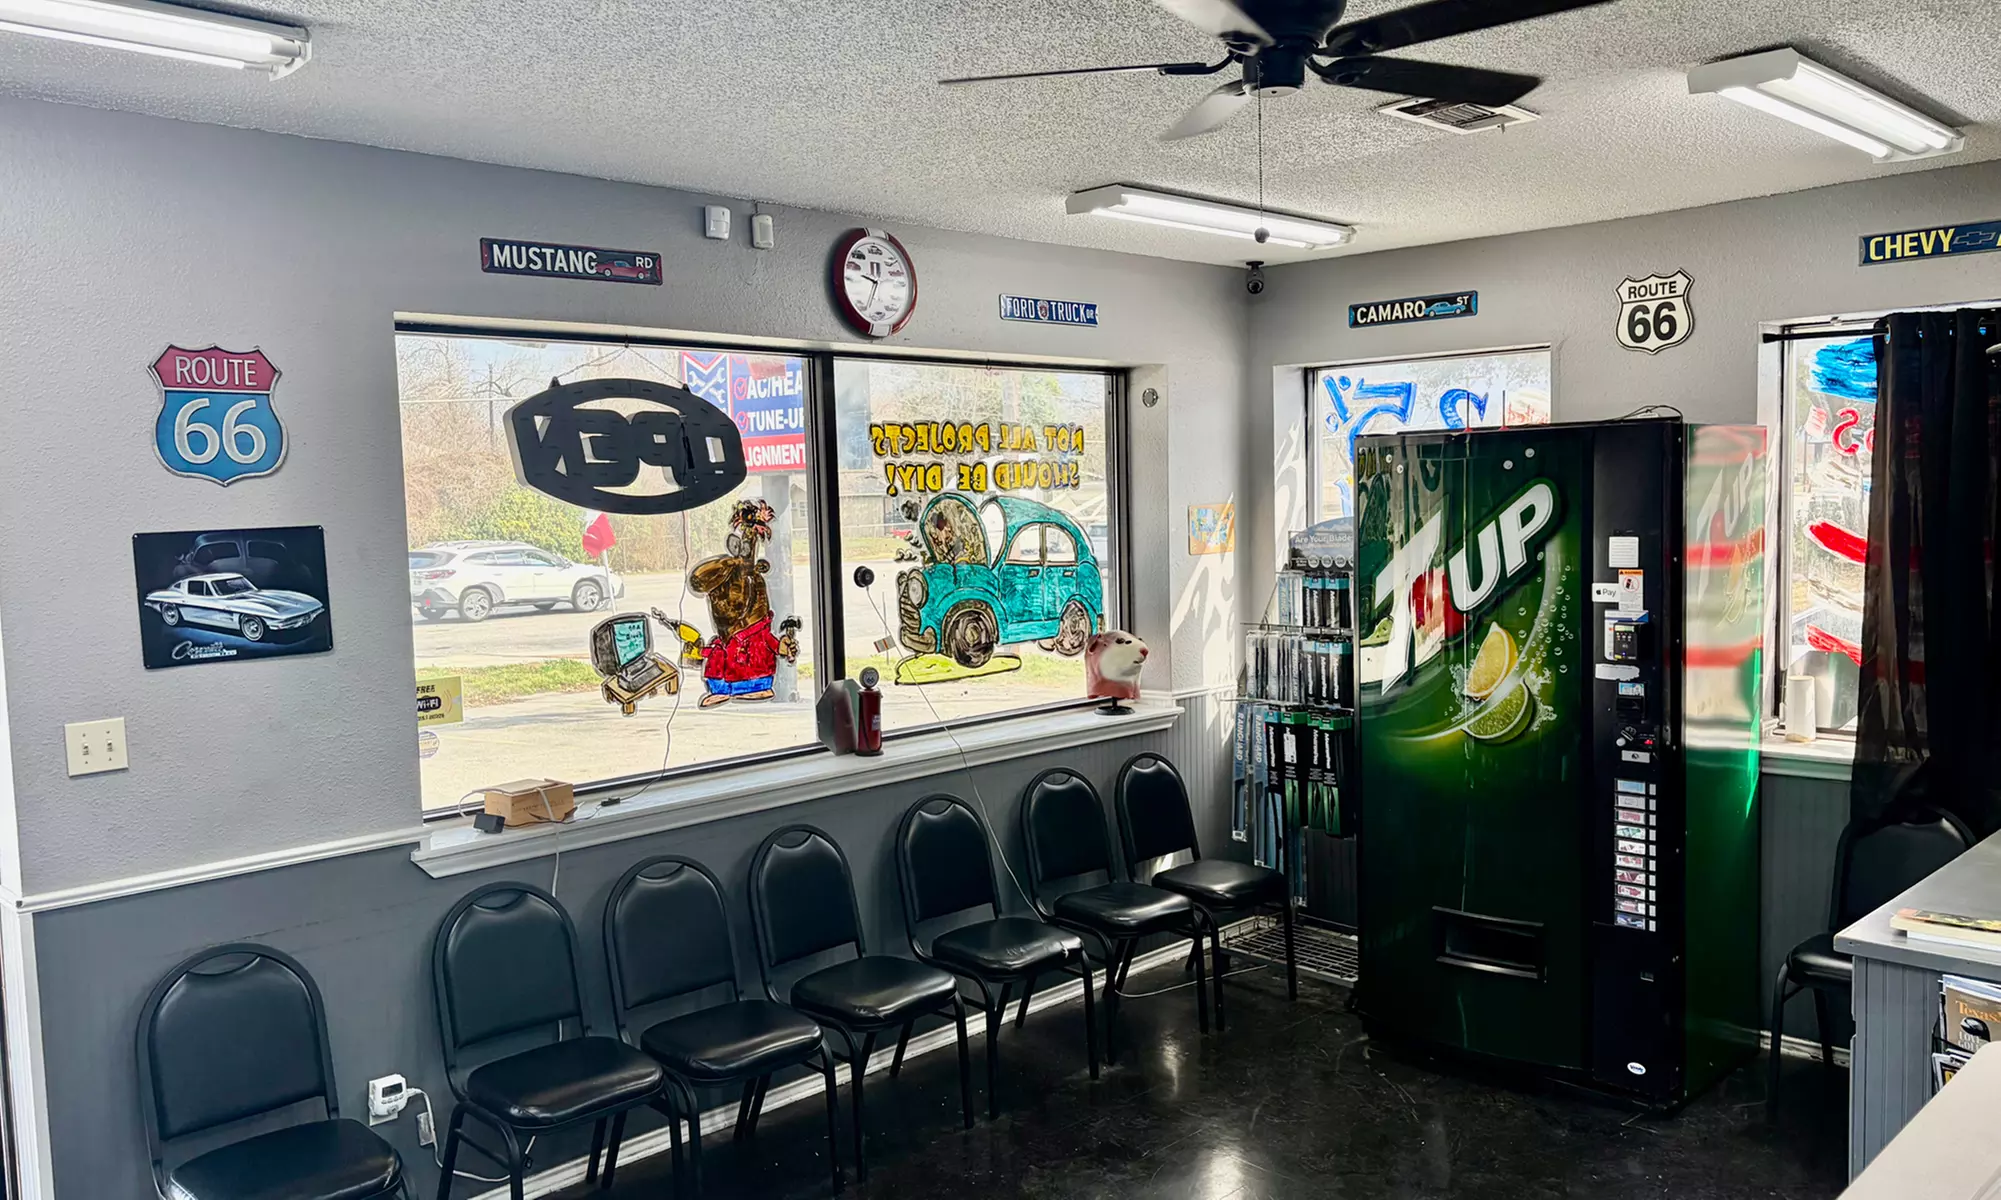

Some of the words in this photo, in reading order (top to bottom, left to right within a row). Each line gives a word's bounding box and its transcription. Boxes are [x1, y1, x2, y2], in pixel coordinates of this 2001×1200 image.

[492, 244, 598, 274] MUSTANG
[635, 256, 653, 269] RD
[1869, 228, 1956, 261] CHEVY
[1628, 281, 1677, 299] ROUTE
[1006, 297, 1035, 318] FORD
[1050, 301, 1087, 323] TRUCK
[1357, 300, 1426, 324] CAMARO
[1456, 295, 1470, 306] ST
[1627, 301, 1677, 344] 66
[175, 355, 258, 386] ROUTE
[174, 397, 267, 465] 66
[1295, 534, 1309, 543] Are
[1309, 534, 1327, 544] Your
[1602, 588, 1617, 598] Pay
[1255, 715, 1263, 762] RAINGUARD
[1956, 1000, 1998, 1023] Texas
